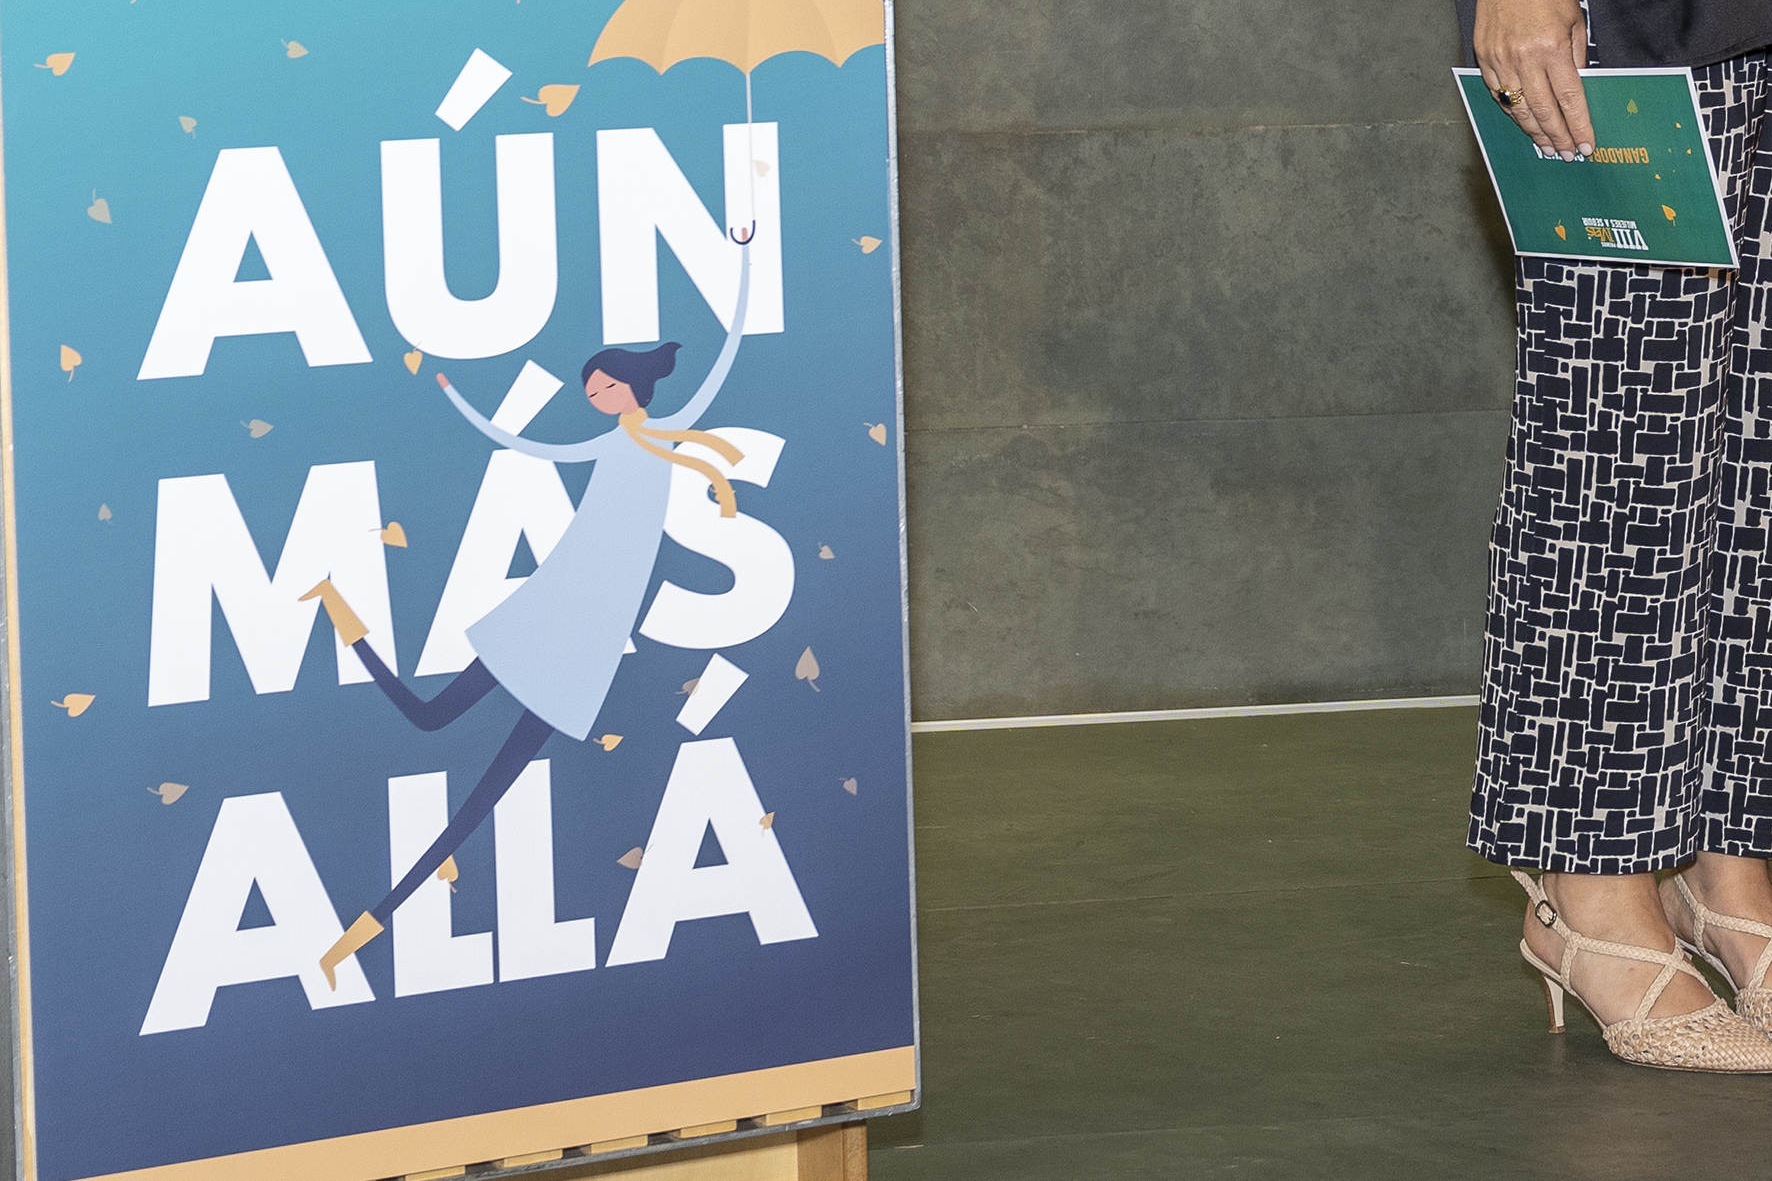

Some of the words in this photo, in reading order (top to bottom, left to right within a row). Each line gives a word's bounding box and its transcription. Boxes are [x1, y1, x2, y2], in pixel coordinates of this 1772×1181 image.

[137, 47, 785, 380] AÚN
[1612, 228, 1649, 250] VIII
[148, 359, 796, 708] MÁS
[139, 653, 819, 1036] ALLÁ
